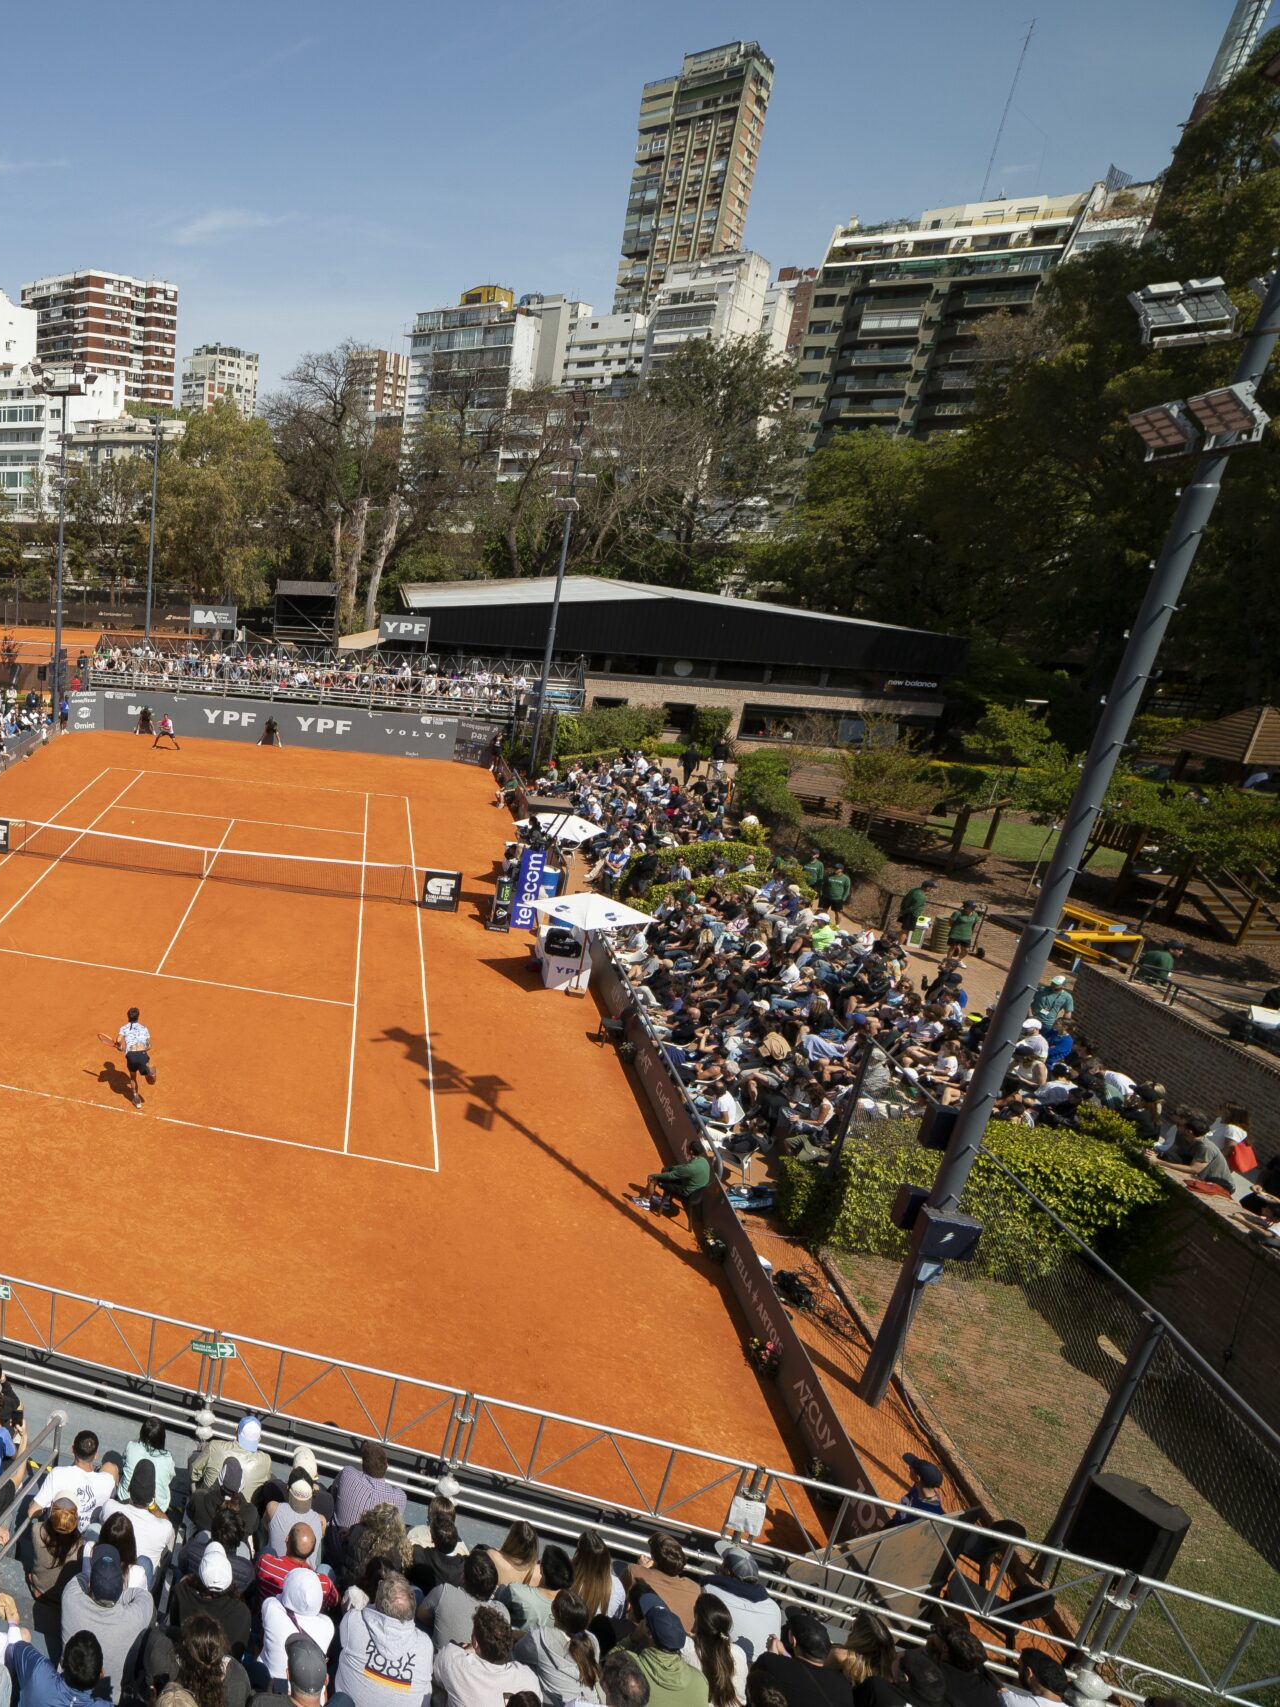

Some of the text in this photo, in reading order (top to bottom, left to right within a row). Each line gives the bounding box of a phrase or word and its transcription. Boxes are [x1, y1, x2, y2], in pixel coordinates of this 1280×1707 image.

[193, 610, 217, 625] BA
[384, 621, 427, 635] YPF
[904, 680, 938, 689] balance
[202, 708, 257, 727] YPF
[296, 716, 353, 735] YPF
[384, 728, 447, 740] VOLVO
[470, 731, 488, 742] pax
[425, 893, 453, 902] CHALLENGER
[503, 885, 511, 901] FORT
[515, 853, 544, 926] telecom
[729, 1244, 785, 1357] STELLA ARTOIS
[792, 1379, 837, 1449] AZCUY
[365, 1651, 413, 1681] 1985
